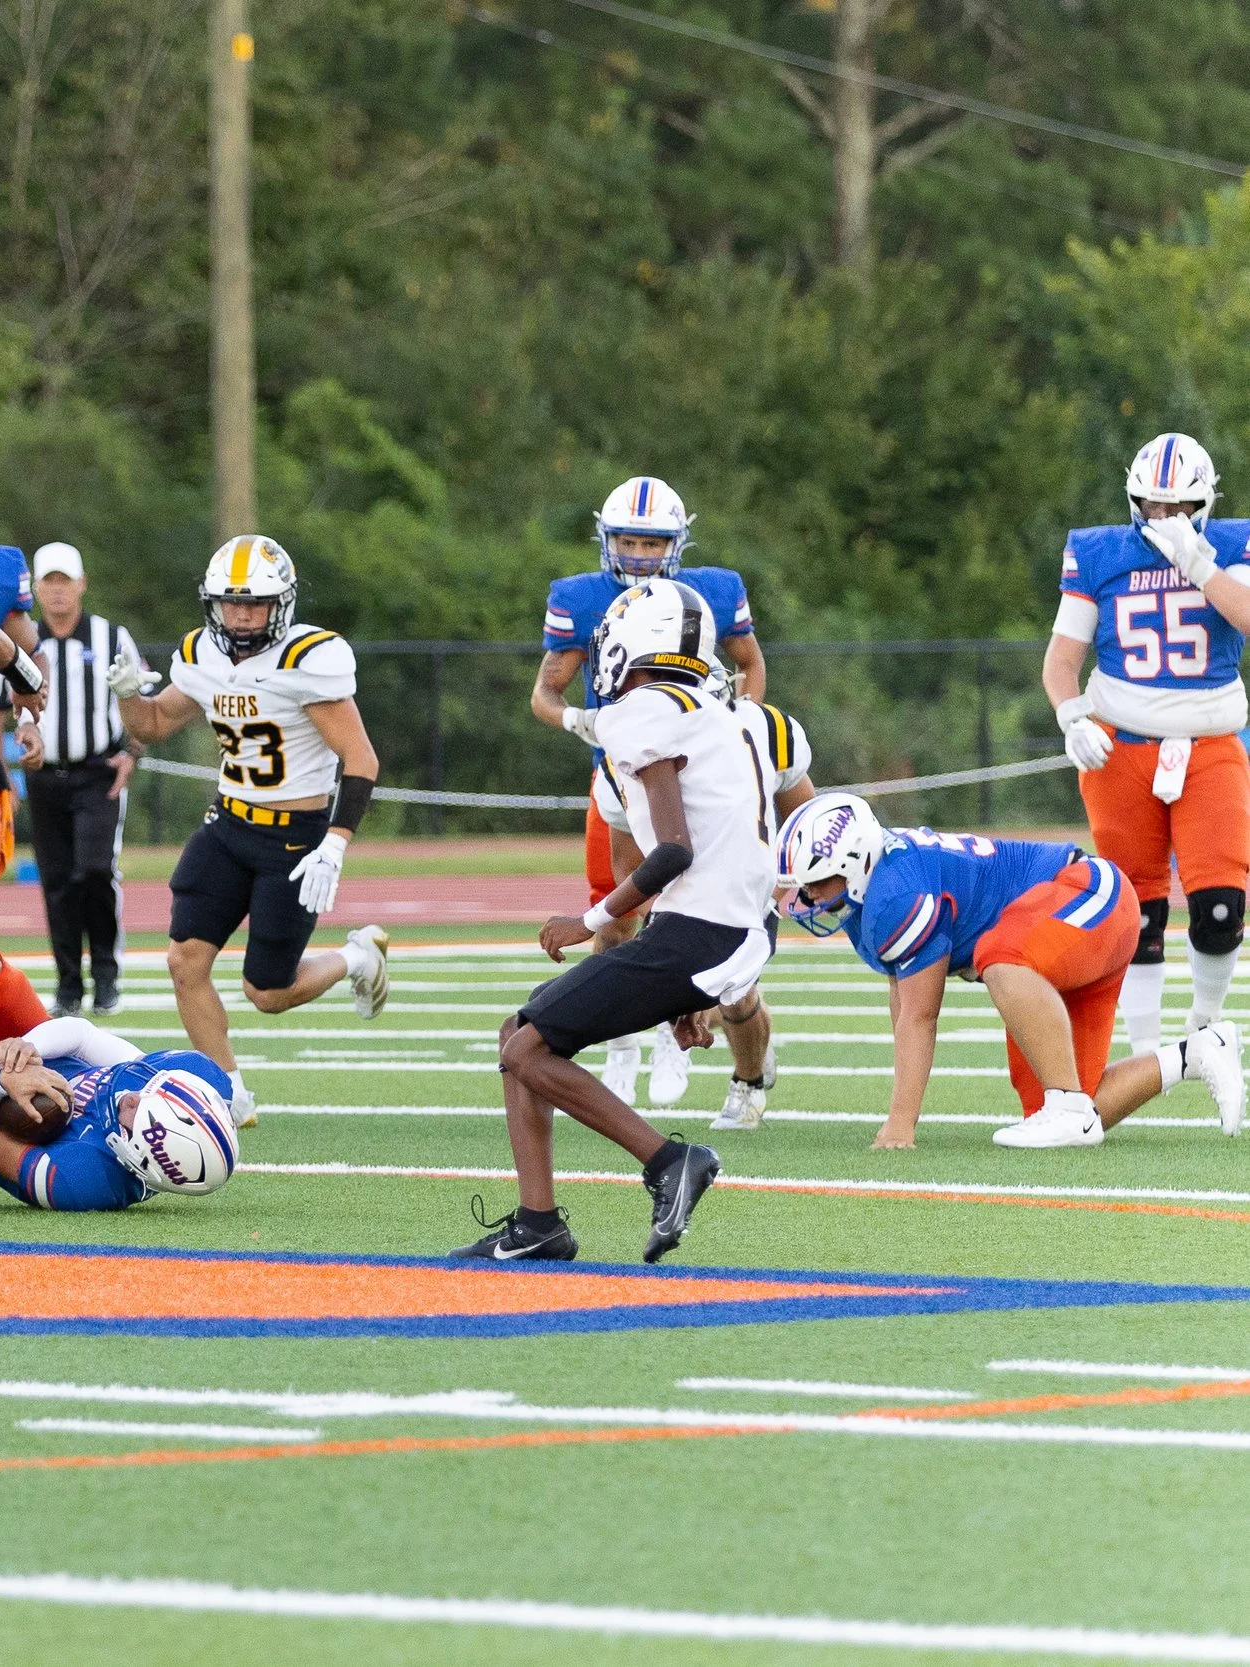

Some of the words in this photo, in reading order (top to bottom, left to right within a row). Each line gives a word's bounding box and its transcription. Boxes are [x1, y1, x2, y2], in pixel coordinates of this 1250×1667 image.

[1114, 590, 1209, 679] 55
[213, 694, 259, 718] NEERS
[211, 719, 286, 790] 23
[811, 807, 854, 858] Bruins
[142, 1121, 188, 1186] Bruins
